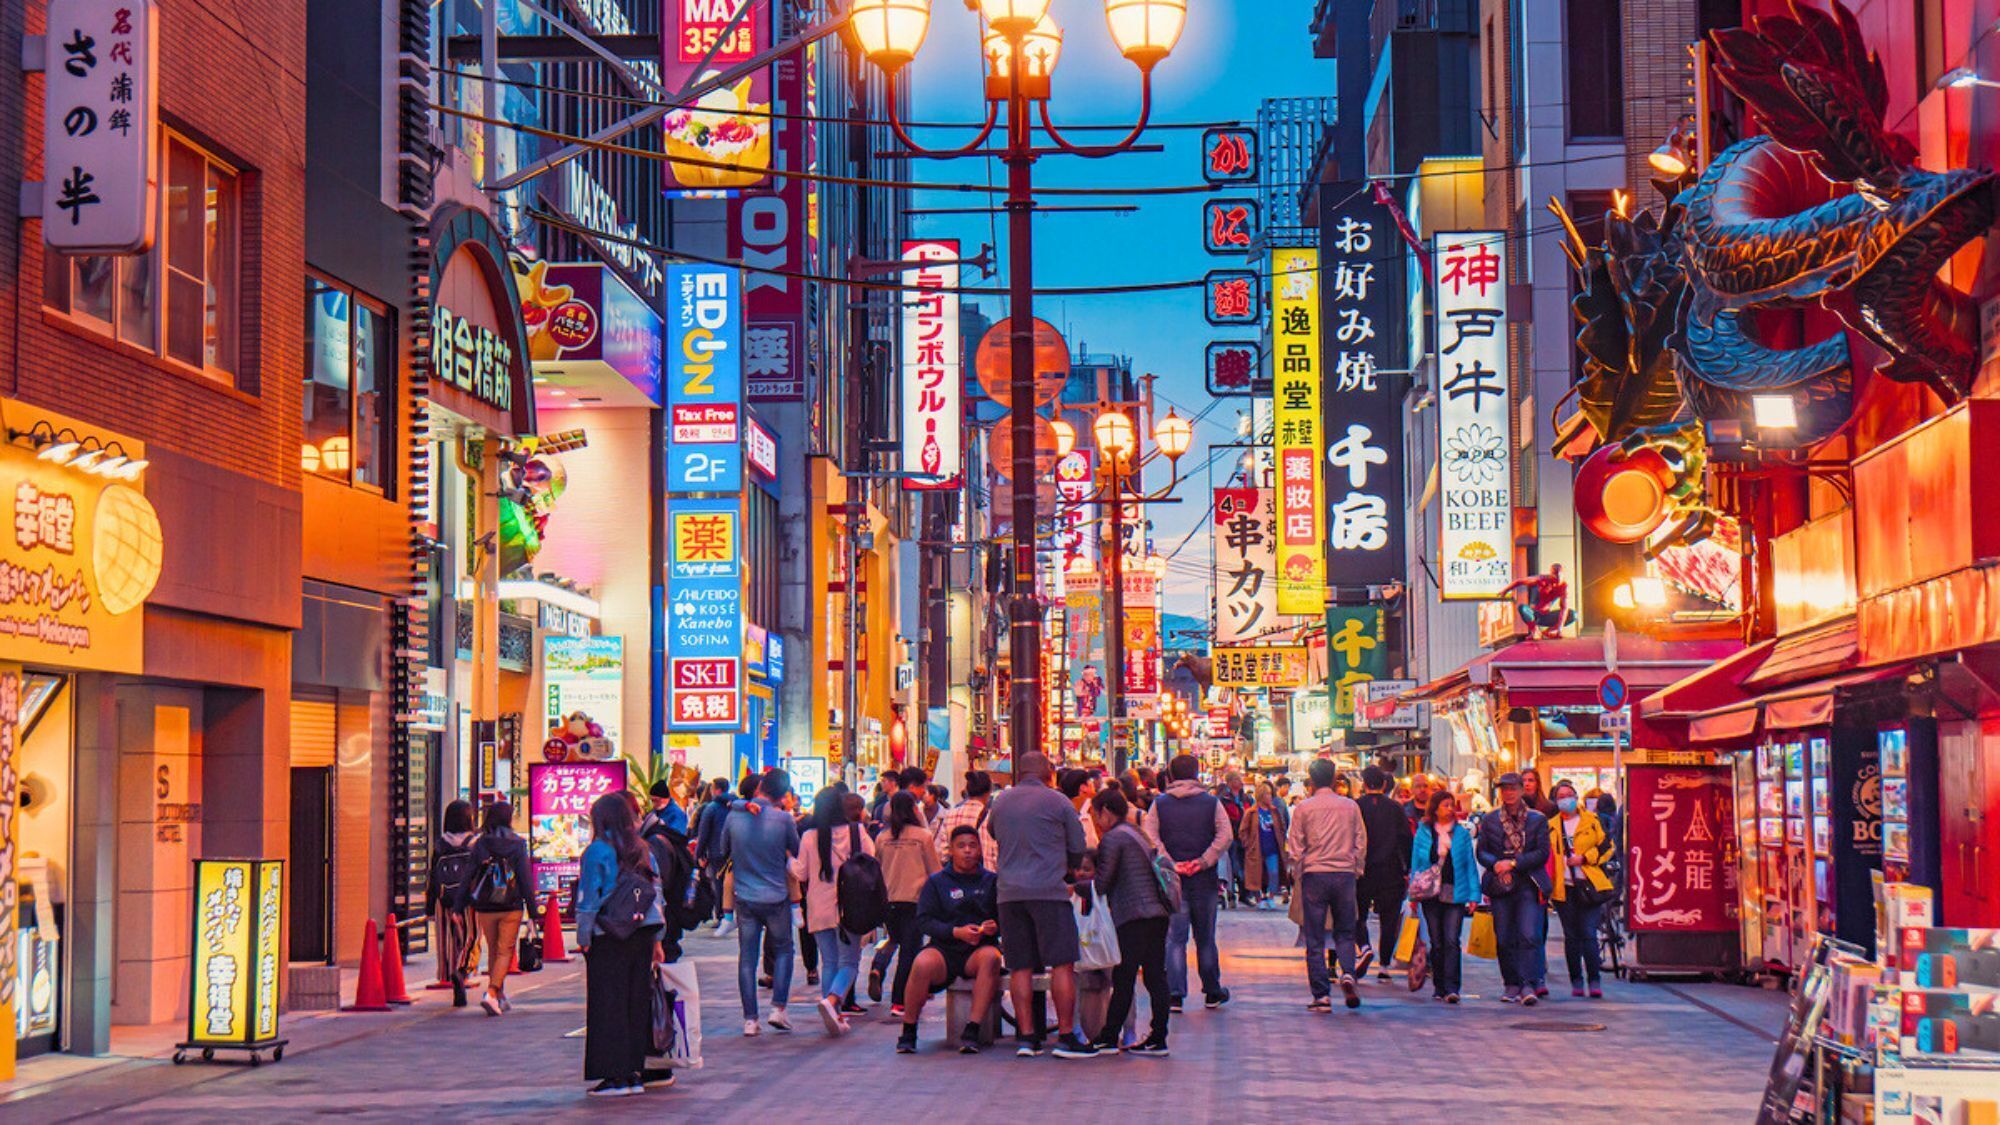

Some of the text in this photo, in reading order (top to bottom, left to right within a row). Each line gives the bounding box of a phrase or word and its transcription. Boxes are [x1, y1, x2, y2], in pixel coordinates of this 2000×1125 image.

[685, 27, 737, 55] 350
[56, 29, 100, 225] さの半
[1441, 245, 1504, 413] 神戸牛
[1281, 306, 1313, 410] 逸品堂
[676, 409, 735, 421] Tax Free
[684, 453, 728, 483] 2F
[1328, 424, 1388, 551] 千房
[1446, 489, 1508, 507] KOBE
[1449, 512, 1506, 530] BEEF
[683, 516, 726, 559] 薬
[1225, 514, 1265, 636] 串カツ
[673, 588, 738, 600] SHISEIDO
[678, 616, 733, 630] Kanebo
[680, 634, 729, 645] SOFINA
[682, 695, 729, 718] 免税
[542, 771, 613, 793] カラオケ
[1650, 793, 1678, 906] ラーメン
[206, 953, 238, 1036] 幸福堂
